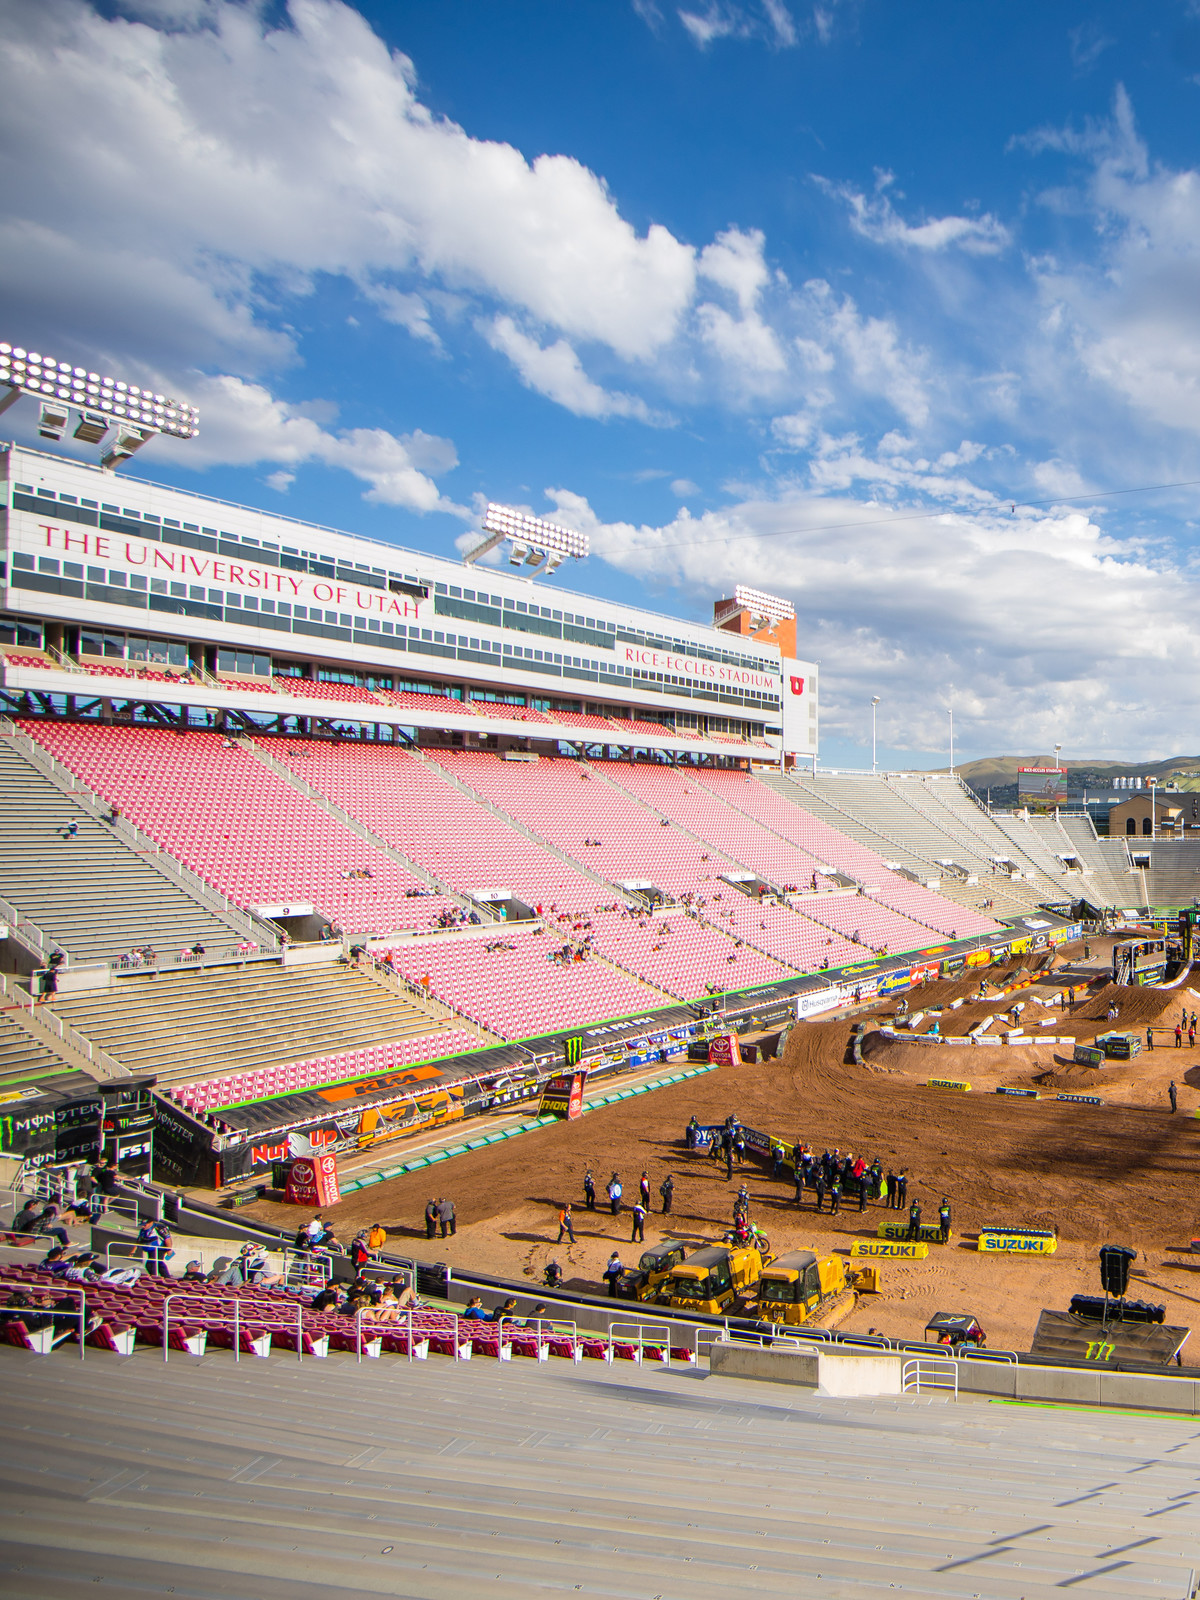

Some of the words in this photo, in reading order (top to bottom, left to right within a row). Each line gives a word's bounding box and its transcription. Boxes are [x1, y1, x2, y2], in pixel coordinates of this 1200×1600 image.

[39, 524, 110, 558] THE
[125, 543, 303, 596] UNIVERSITY
[313, 583, 347, 604] OF
[357, 591, 419, 619] UTAH
[626, 648, 715, 677] RICE-ECCLES
[719, 667, 773, 688] STADIUM
[282, 907, 290, 916] 9
[354, 1074, 418, 1095] KTM
[931, 1080, 963, 1090] SUZUKI
[481, 1085, 538, 1108] OAKLEY
[541, 1100, 568, 1111] THOR
[1067, 1096, 1099, 1104] OAKLEY
[15, 1102, 100, 1131] MONSTER
[30, 1116, 90, 1136] ENERGY
[155, 1109, 194, 1143] MONSTER
[309, 1129, 338, 1148] Up
[119, 1141, 151, 1159] FS1
[251, 1139, 291, 1166] Nut
[289, 1184, 317, 1194] TOYOTA
[328, 1171, 339, 1203] TOYOTA
[858, 1245, 916, 1257] SUZUKI
[985, 1238, 1044, 1251] SUZUKI
[773, 1310, 785, 1319] CAT
